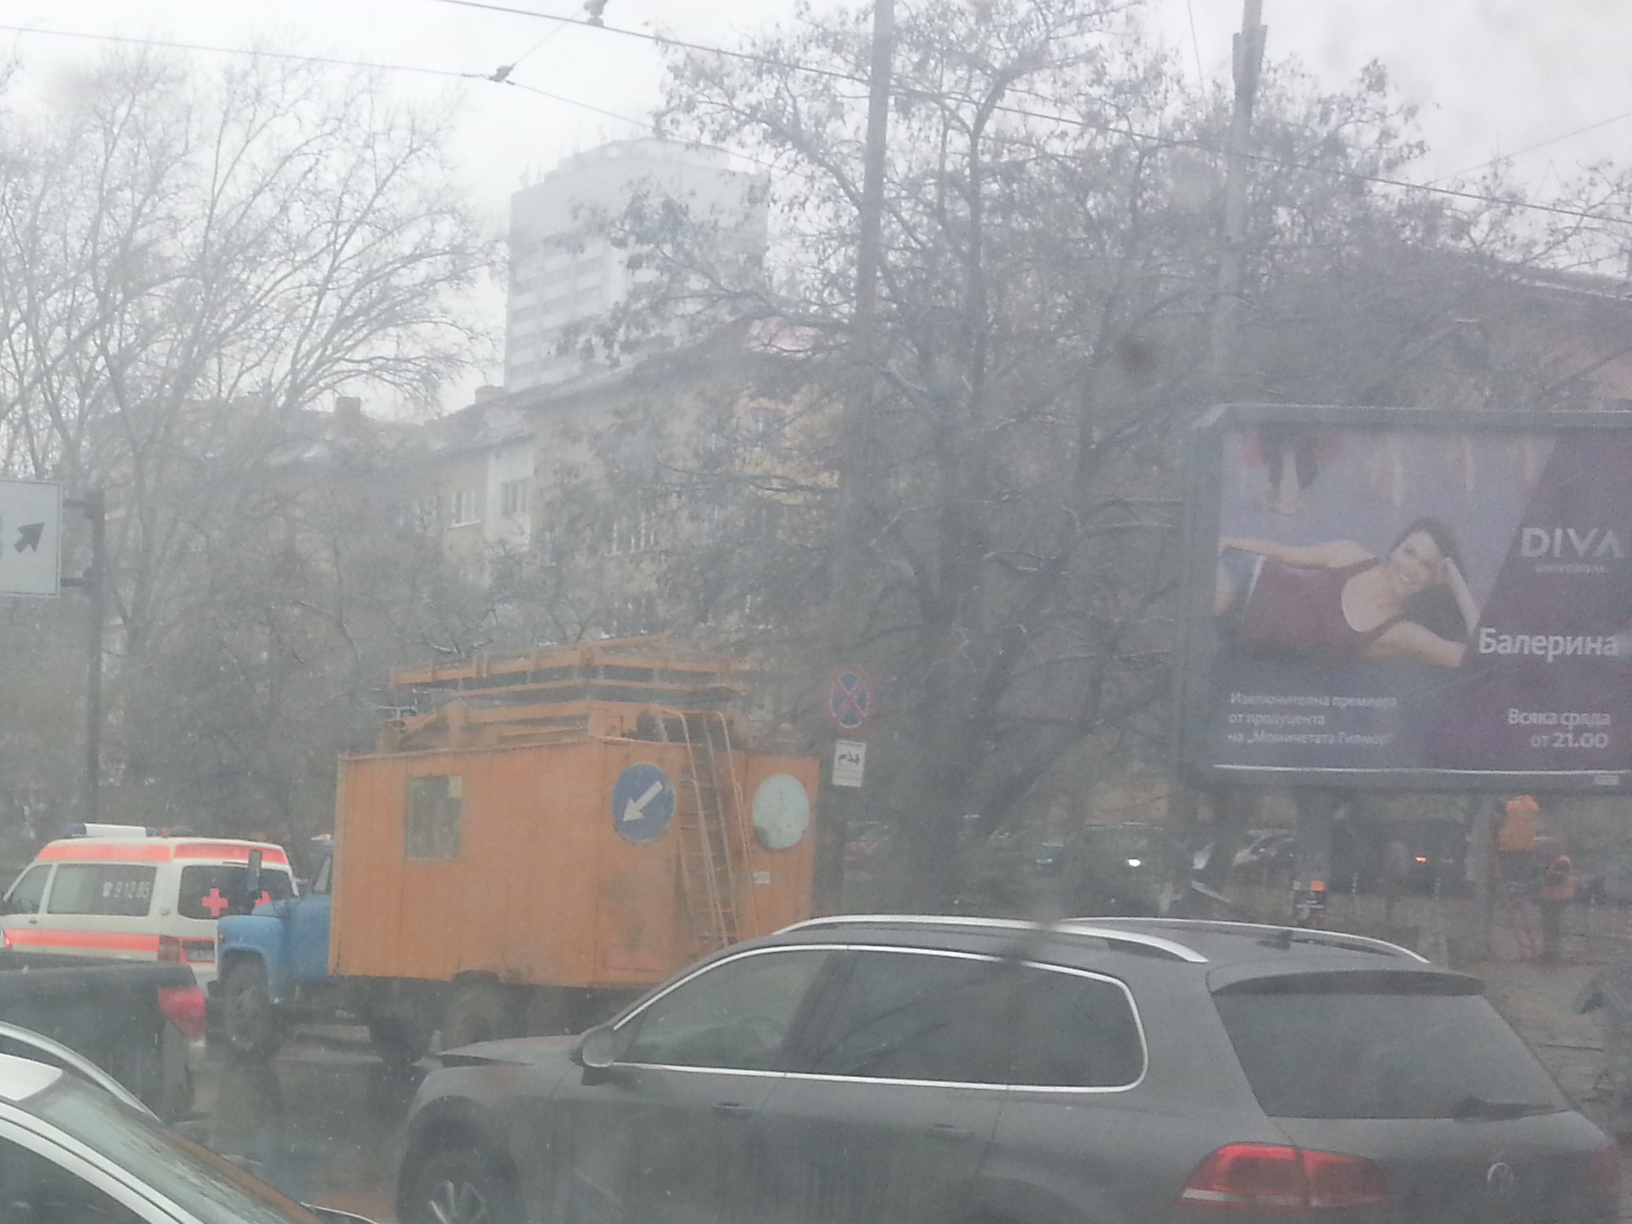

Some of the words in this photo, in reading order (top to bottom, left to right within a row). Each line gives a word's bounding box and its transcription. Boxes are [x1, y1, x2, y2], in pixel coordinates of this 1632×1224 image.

[1521, 527, 1626, 558] DIVA
[1479, 627, 1618, 662] Балерина
[1509, 708, 1557, 725] Всяка
[1553, 732, 1608, 748] 21.00
